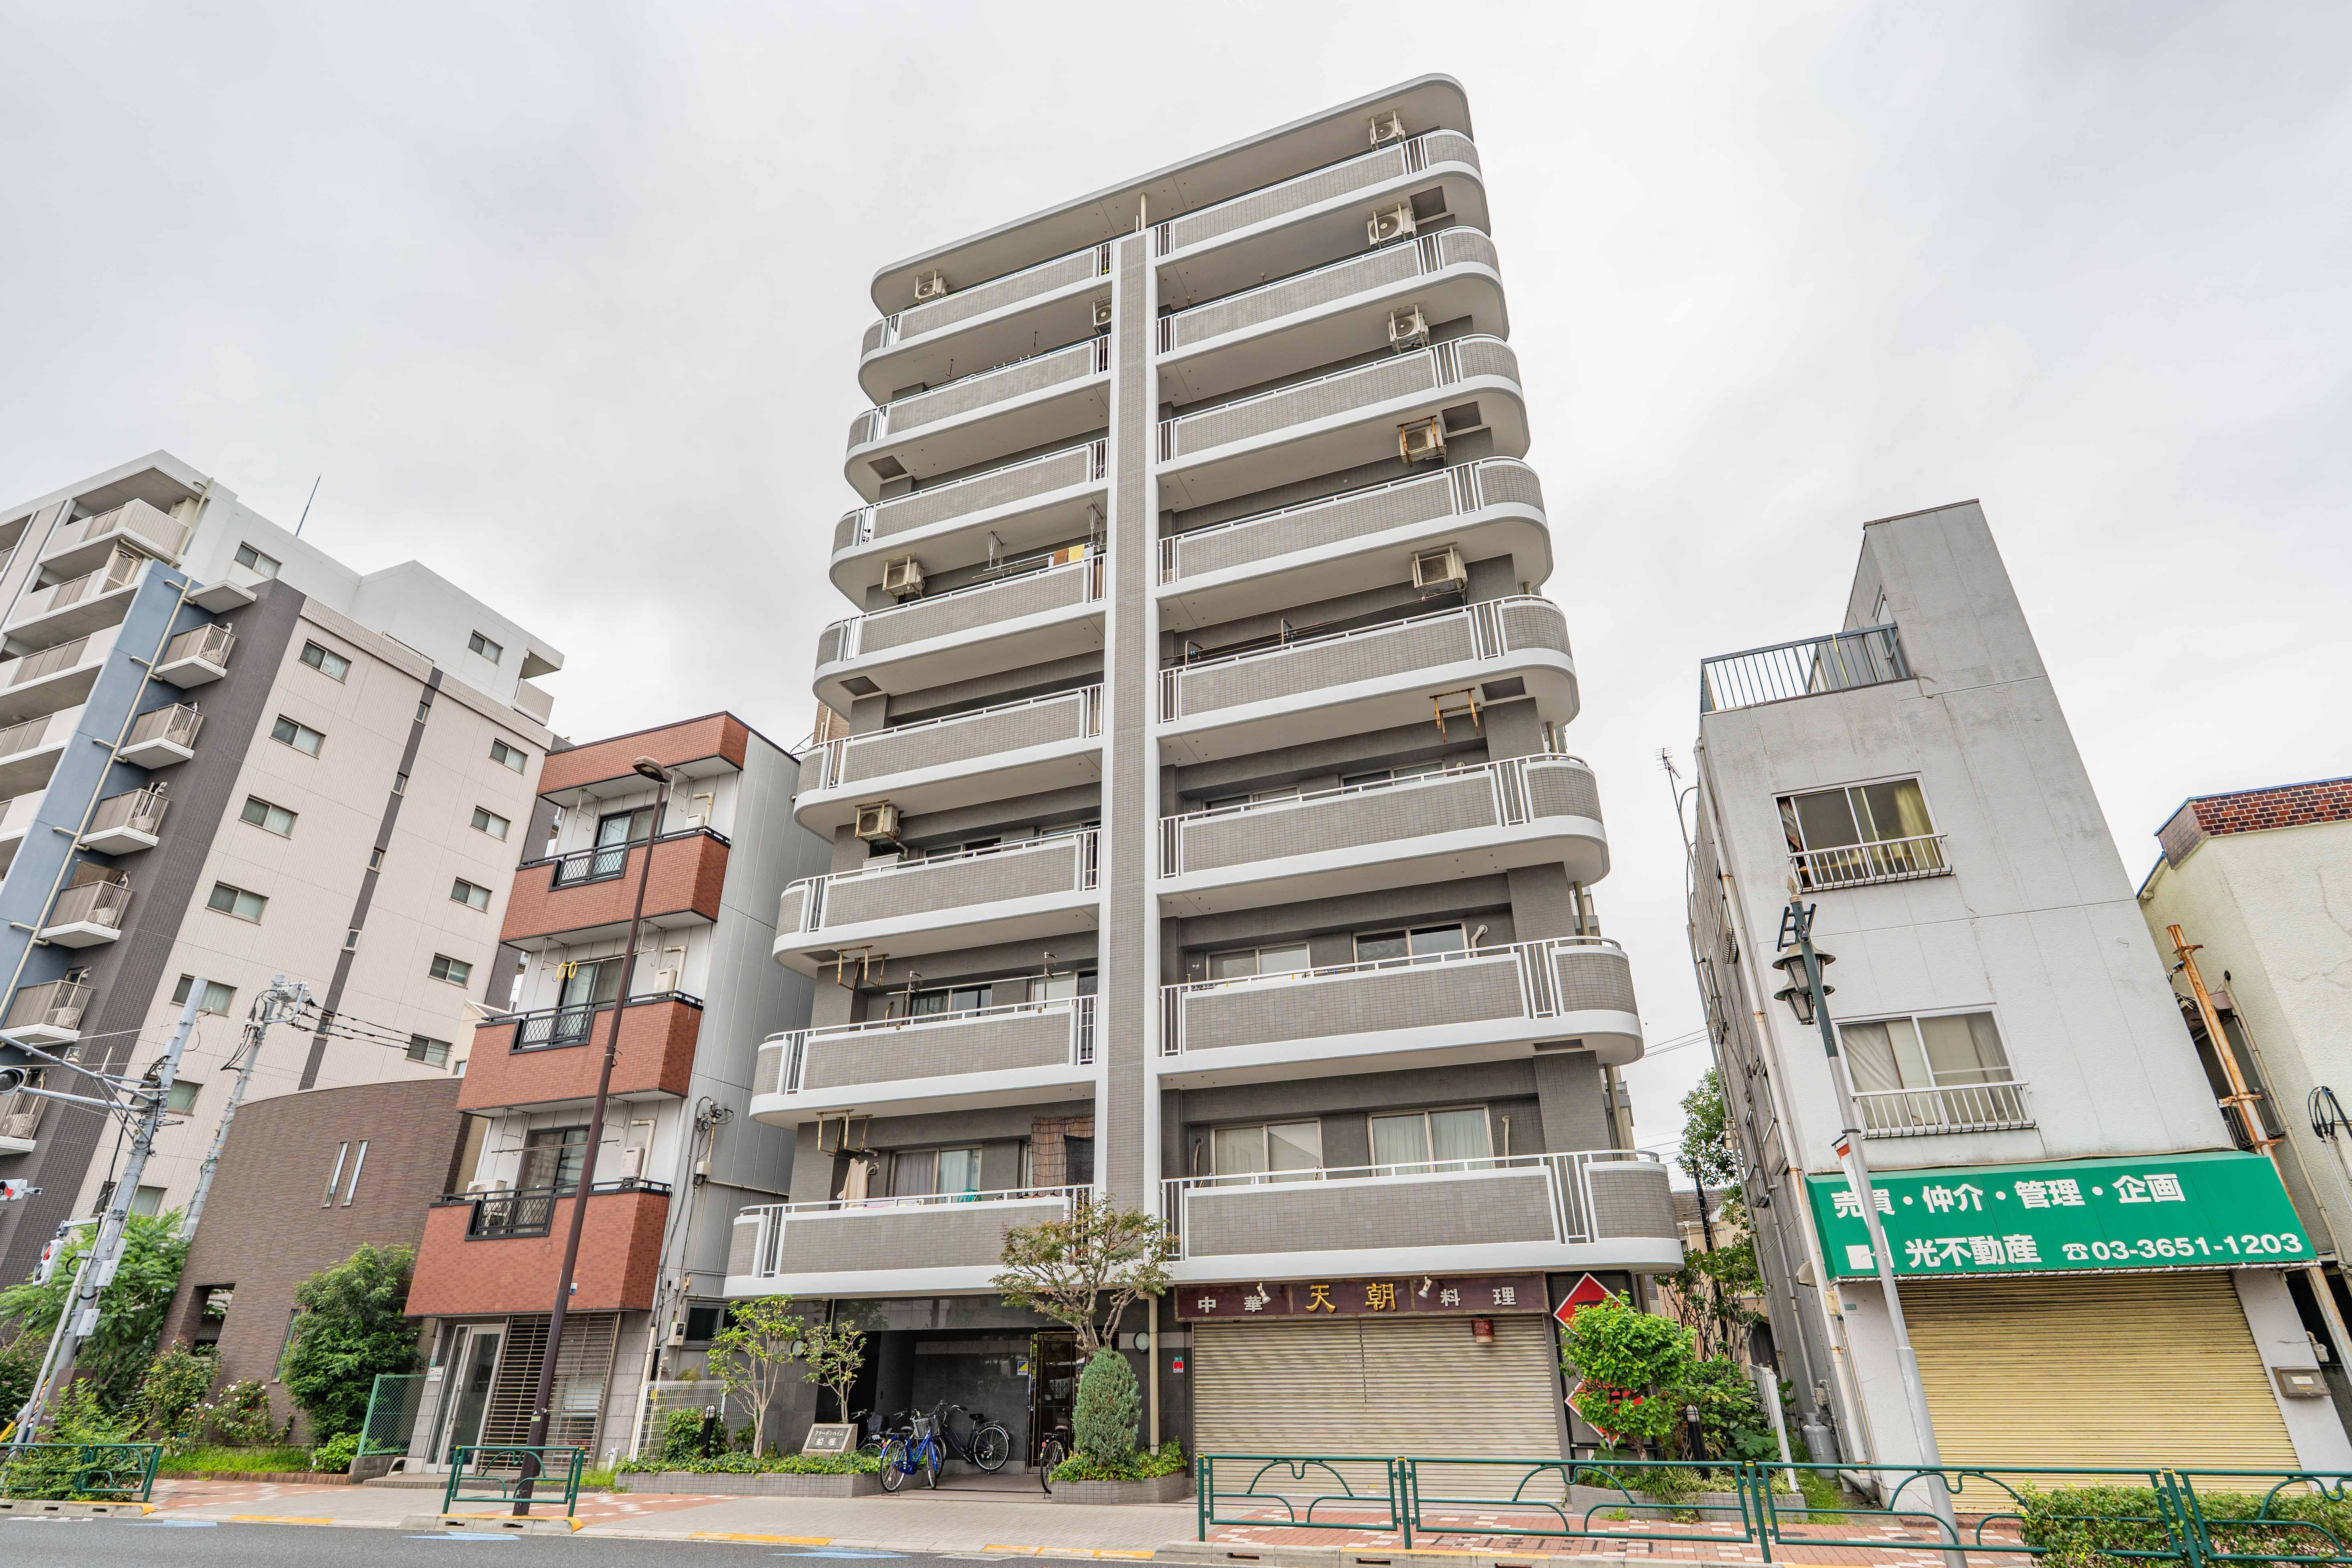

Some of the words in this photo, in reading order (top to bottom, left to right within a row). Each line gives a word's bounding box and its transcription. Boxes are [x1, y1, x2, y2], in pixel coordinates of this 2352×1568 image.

[1904, 1234, 2042, 1268] 光不動産
[2091, 1233, 2303, 1260] 03-3651-1203
[1198, 1295, 1263, 1313] 中華
[1306, 1282, 1396, 1313] 天朝
[1440, 1287, 1517, 1307] 料理
